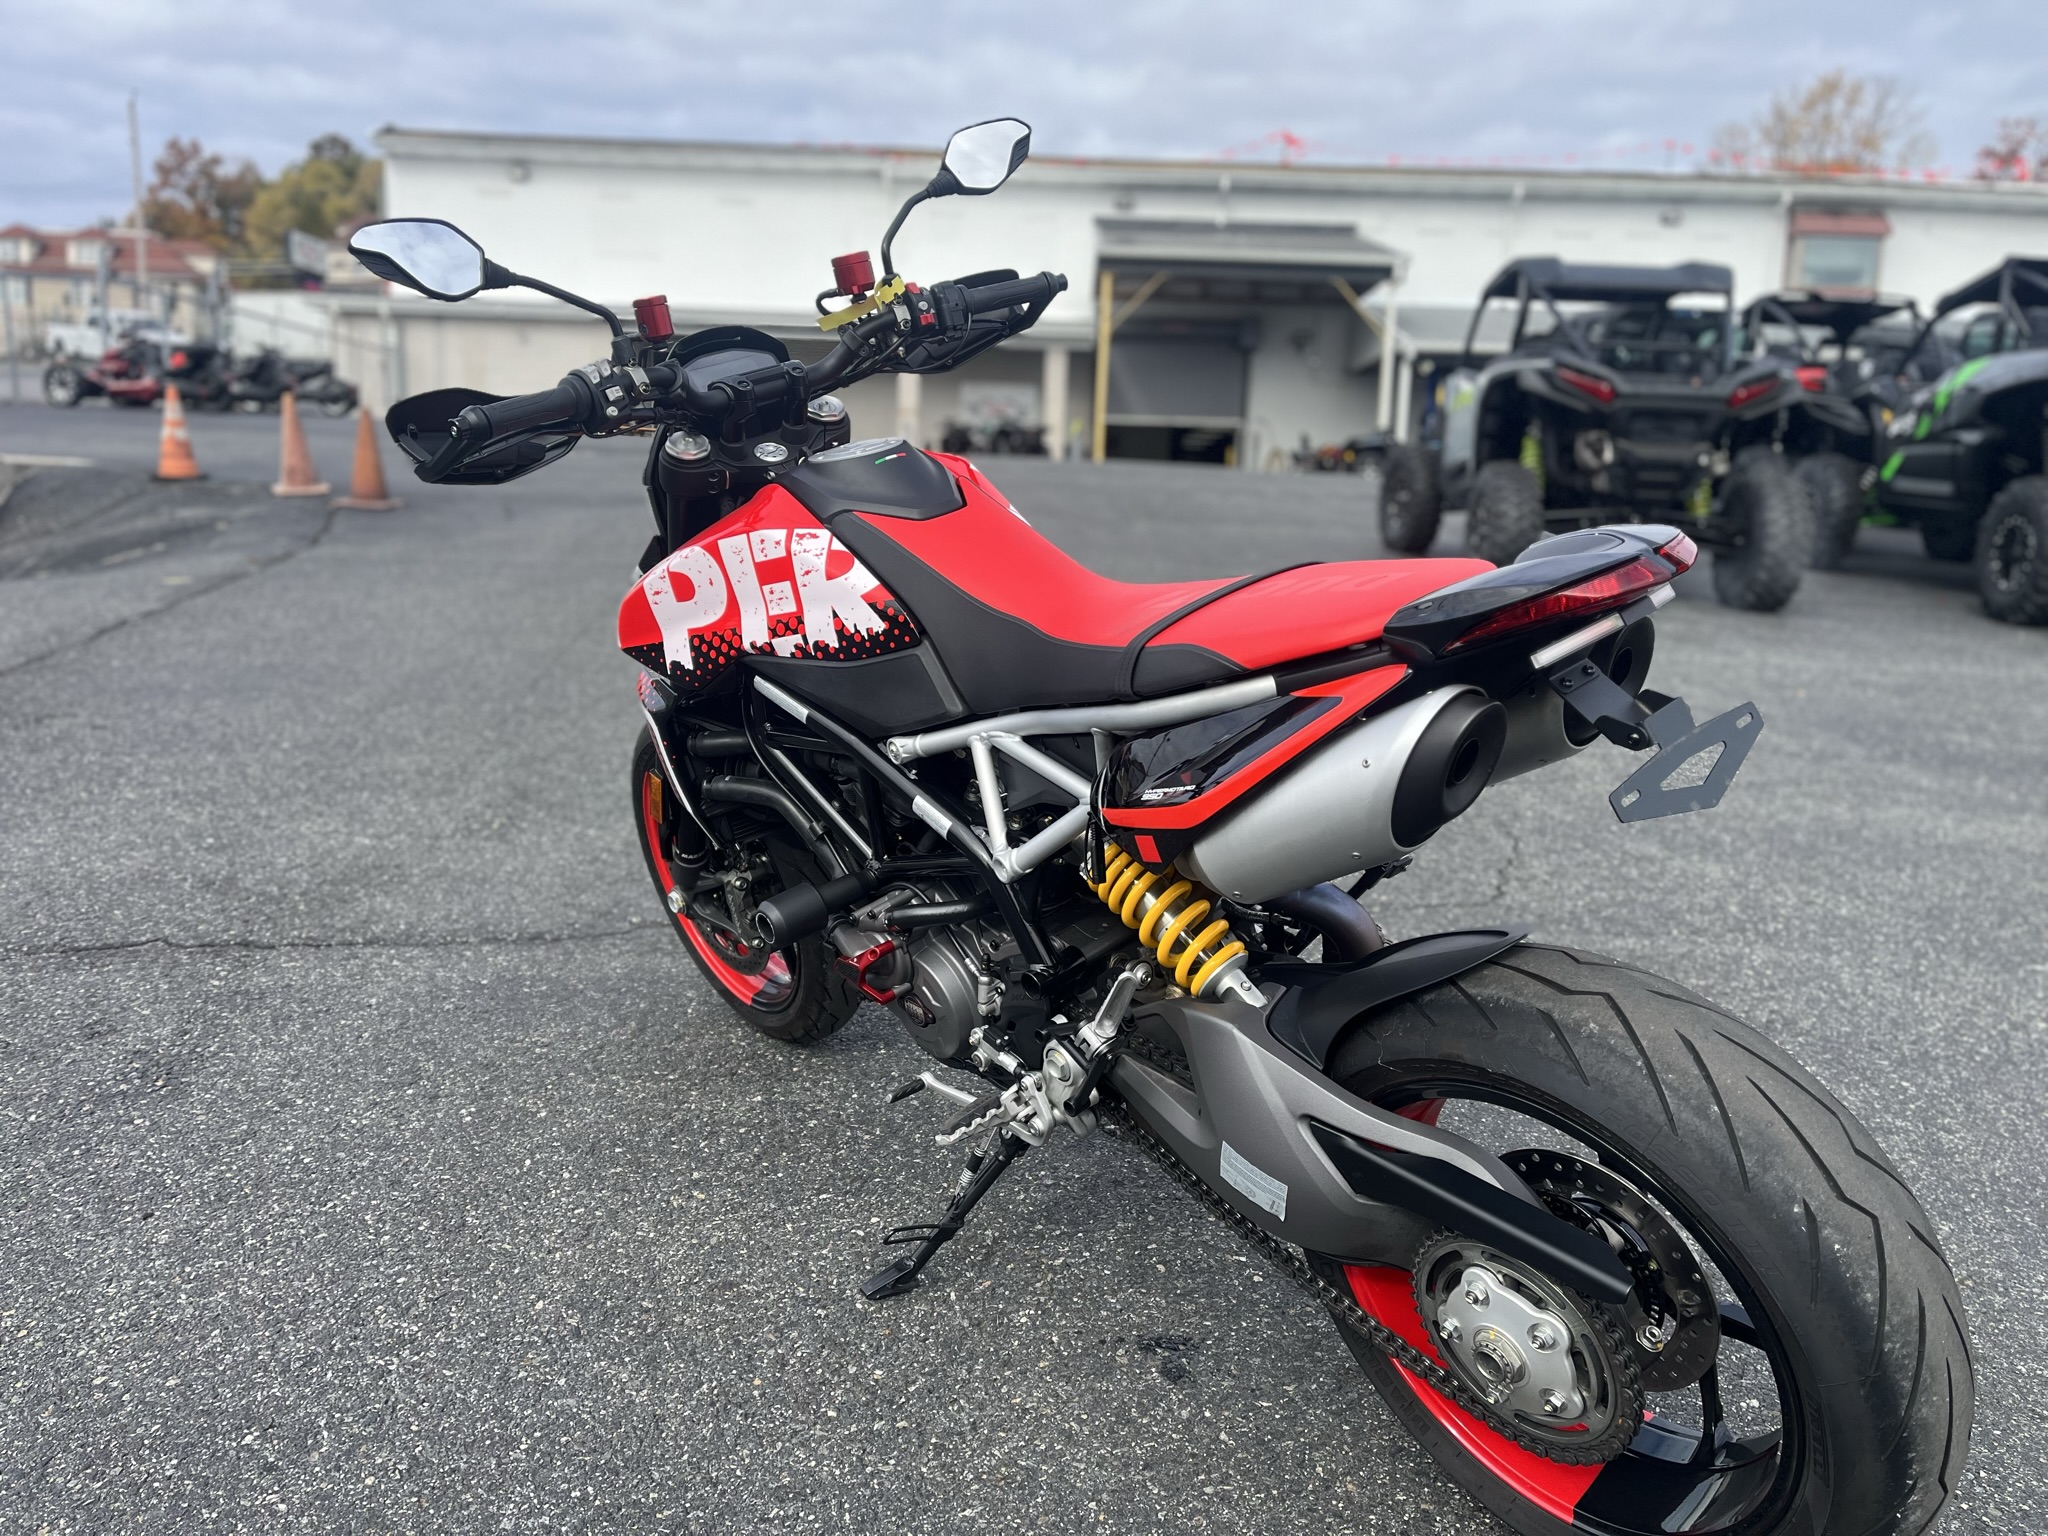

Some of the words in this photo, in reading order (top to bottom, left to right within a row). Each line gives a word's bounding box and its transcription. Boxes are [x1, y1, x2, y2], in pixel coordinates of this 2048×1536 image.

[644, 528, 887, 674] PER
[1145, 785, 1196, 794] HYPERMOTARD
[1141, 793, 1164, 801] 950
